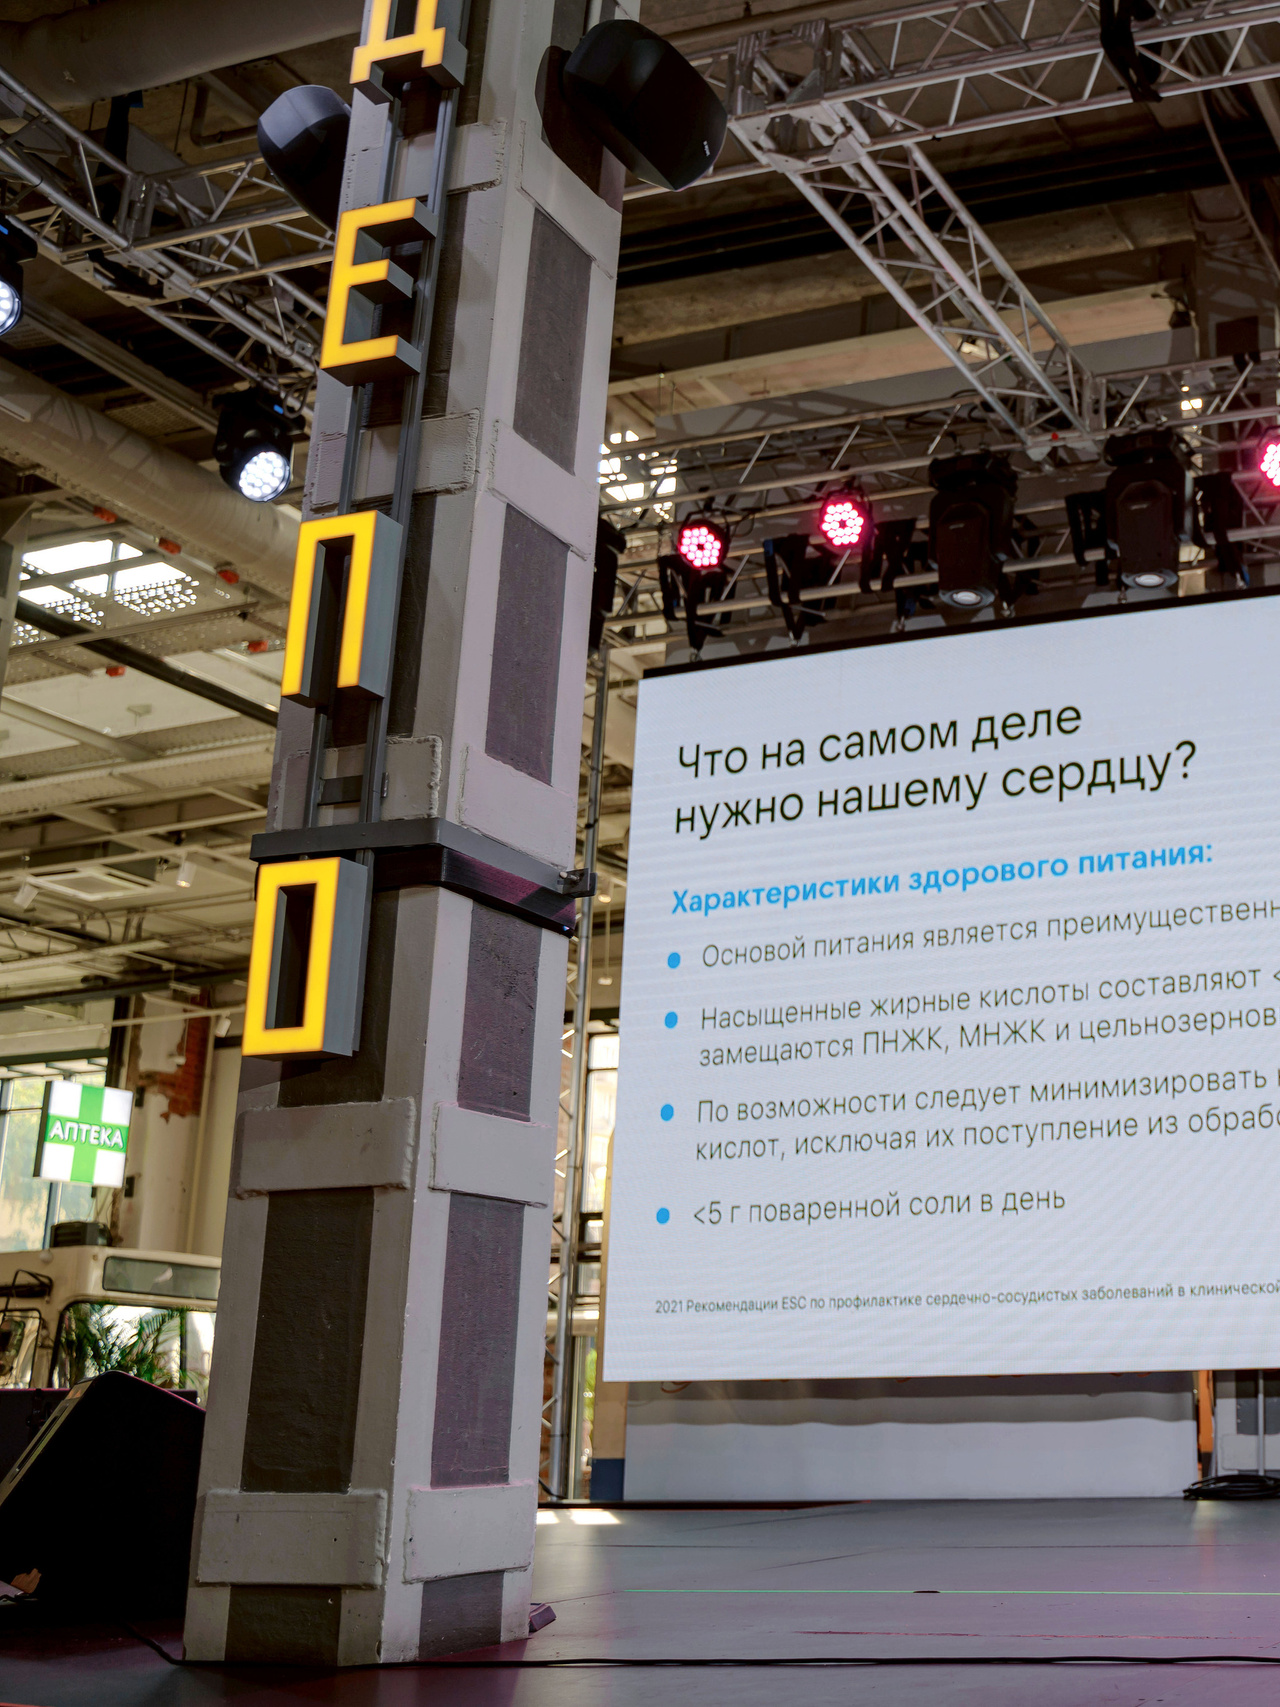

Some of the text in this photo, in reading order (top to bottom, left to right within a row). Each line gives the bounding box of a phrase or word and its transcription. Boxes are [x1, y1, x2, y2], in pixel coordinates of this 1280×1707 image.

[679, 706, 1082, 778] Что на самом деле
[676, 741, 1196, 840] нужно нашему сердцу?
[672, 845, 1212, 917] Характеристики здорового питания:
[703, 936, 805, 968] Основой
[815, 931, 913, 957] питания
[924, 921, 1037, 948] является
[702, 1001, 861, 1030] Насыщенные
[871, 992, 970, 1019] жирные
[980, 983, 1088, 1008] кислоты
[1099, 969, 1261, 999] составляют
[700, 1039, 853, 1067] замещаются
[864, 1027, 949, 1055] ПНЖК,
[960, 1019, 1045, 1048] МНЖК
[1056, 1023, 1069, 1041] и
[698, 1100, 728, 1123] По
[737, 1093, 905, 1121] возможности
[916, 1086, 1021, 1112] следует
[1031, 1070, 1267, 1102] минимизировать
[49, 1119, 124, 1149] АПТЕКА
[697, 1139, 785, 1161] кислот,
[796, 1131, 916, 1155] исключая
[927, 1129, 954, 1148] их
[964, 1118, 1138, 1148] поступление
[1149, 1116, 1178, 1135] из
[694, 1191, 1065, 1226] <5 г поваренной соли в день
[655, 1300, 683, 1313] 2021
[686, 1299, 778, 1313] Рекомендации
[782, 1296, 806, 1311] ESC
[811, 1298, 825, 1309] по
[829, 1295, 922, 1310] профилактике
[926, 1290, 1078, 1307] сердечно-сосудистых
[1082, 1284, 1173, 1301] заболеваний
